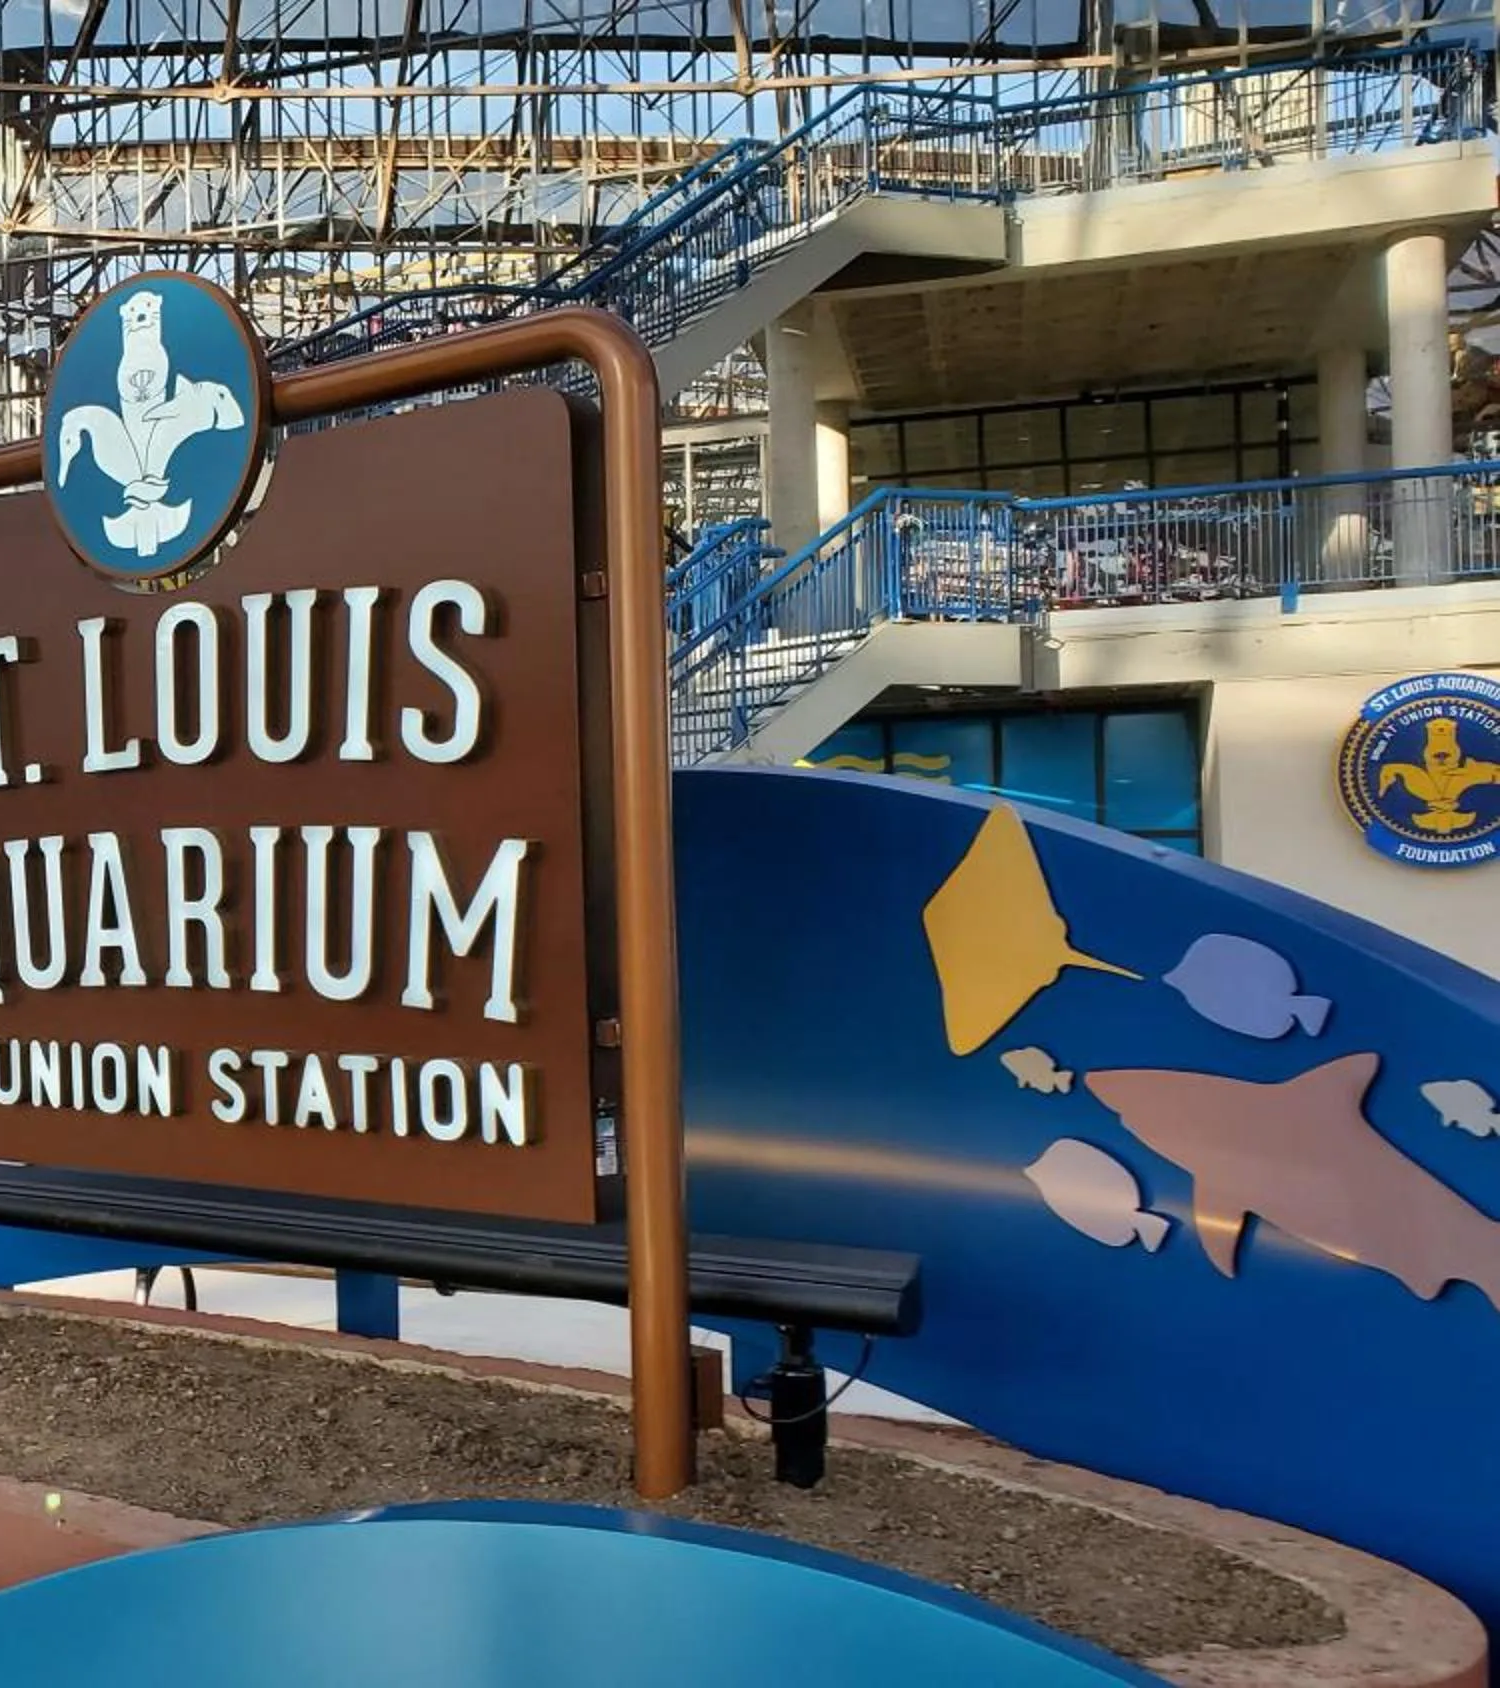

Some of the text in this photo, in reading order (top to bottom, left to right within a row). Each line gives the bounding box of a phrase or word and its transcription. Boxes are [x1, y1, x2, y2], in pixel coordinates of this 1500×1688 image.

[77, 579, 486, 773] LOUIS
[1392, 678, 1434, 700] LOUIS
[1437, 677, 1500, 699] AQUARIU
[1382, 725, 1397, 740] AT
[1400, 706, 1443, 725] UNION
[1396, 842, 1496, 862] FOUNDATION
[208, 1047, 526, 1146] STATION
